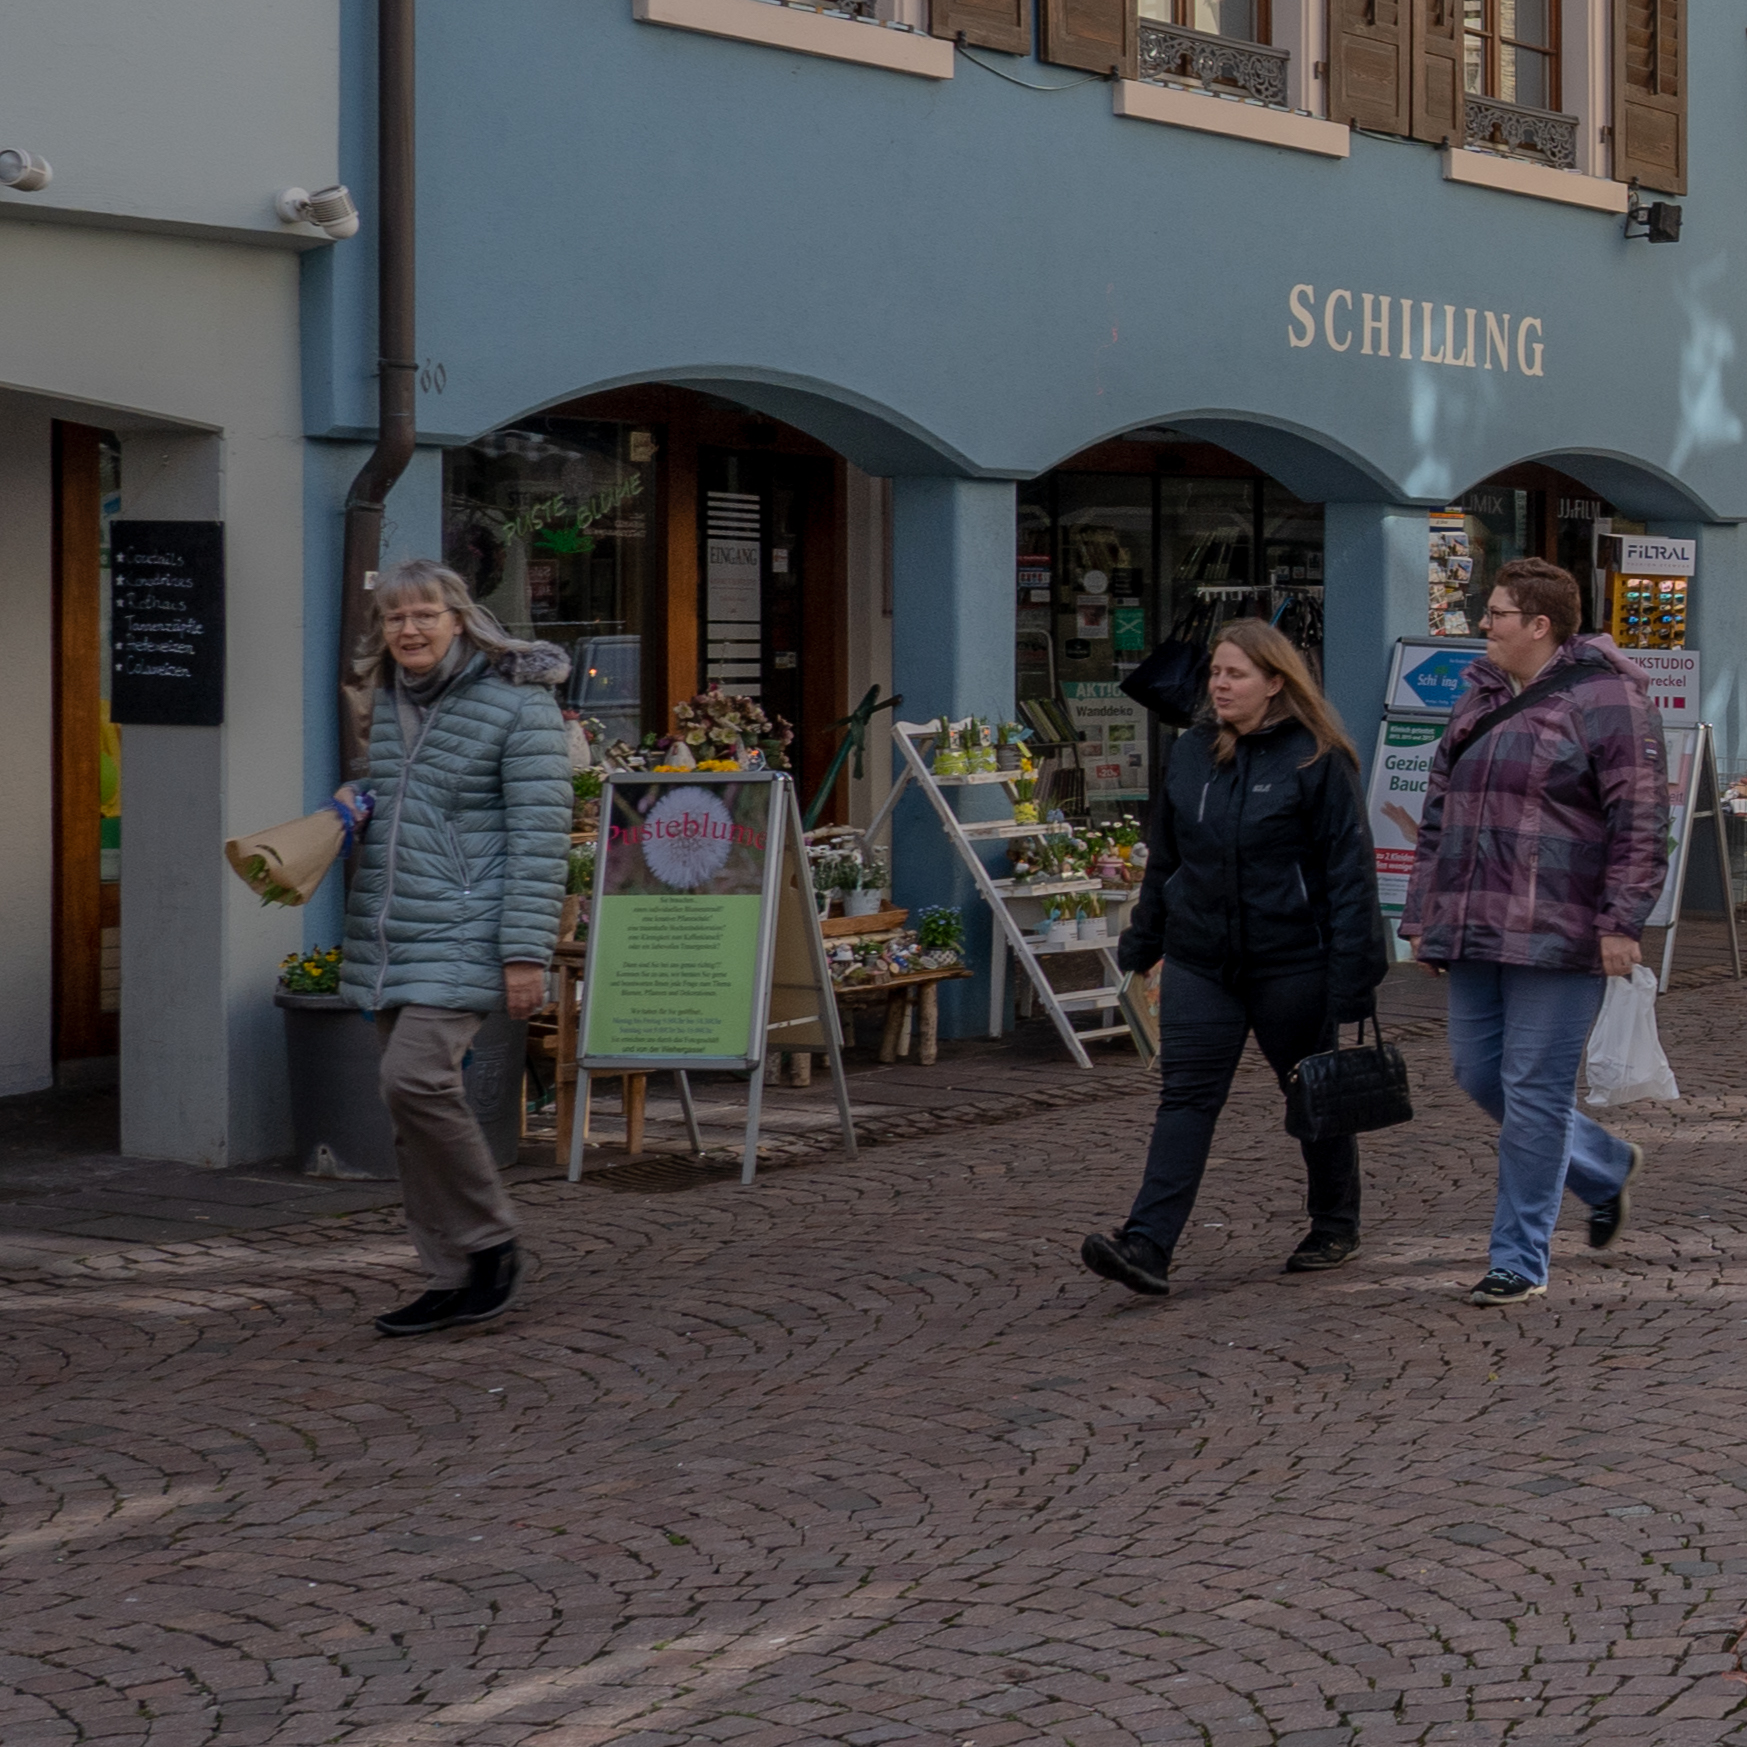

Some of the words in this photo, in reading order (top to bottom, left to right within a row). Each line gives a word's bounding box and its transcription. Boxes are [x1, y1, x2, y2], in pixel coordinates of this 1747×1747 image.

[1288, 284, 1544, 377] SCHILLING
[420, 357, 447, 395] 60
[577, 472, 645, 529] BLUME
[709, 545, 758, 565] EINGANG
[1076, 706, 1134, 718] Wanddeko
